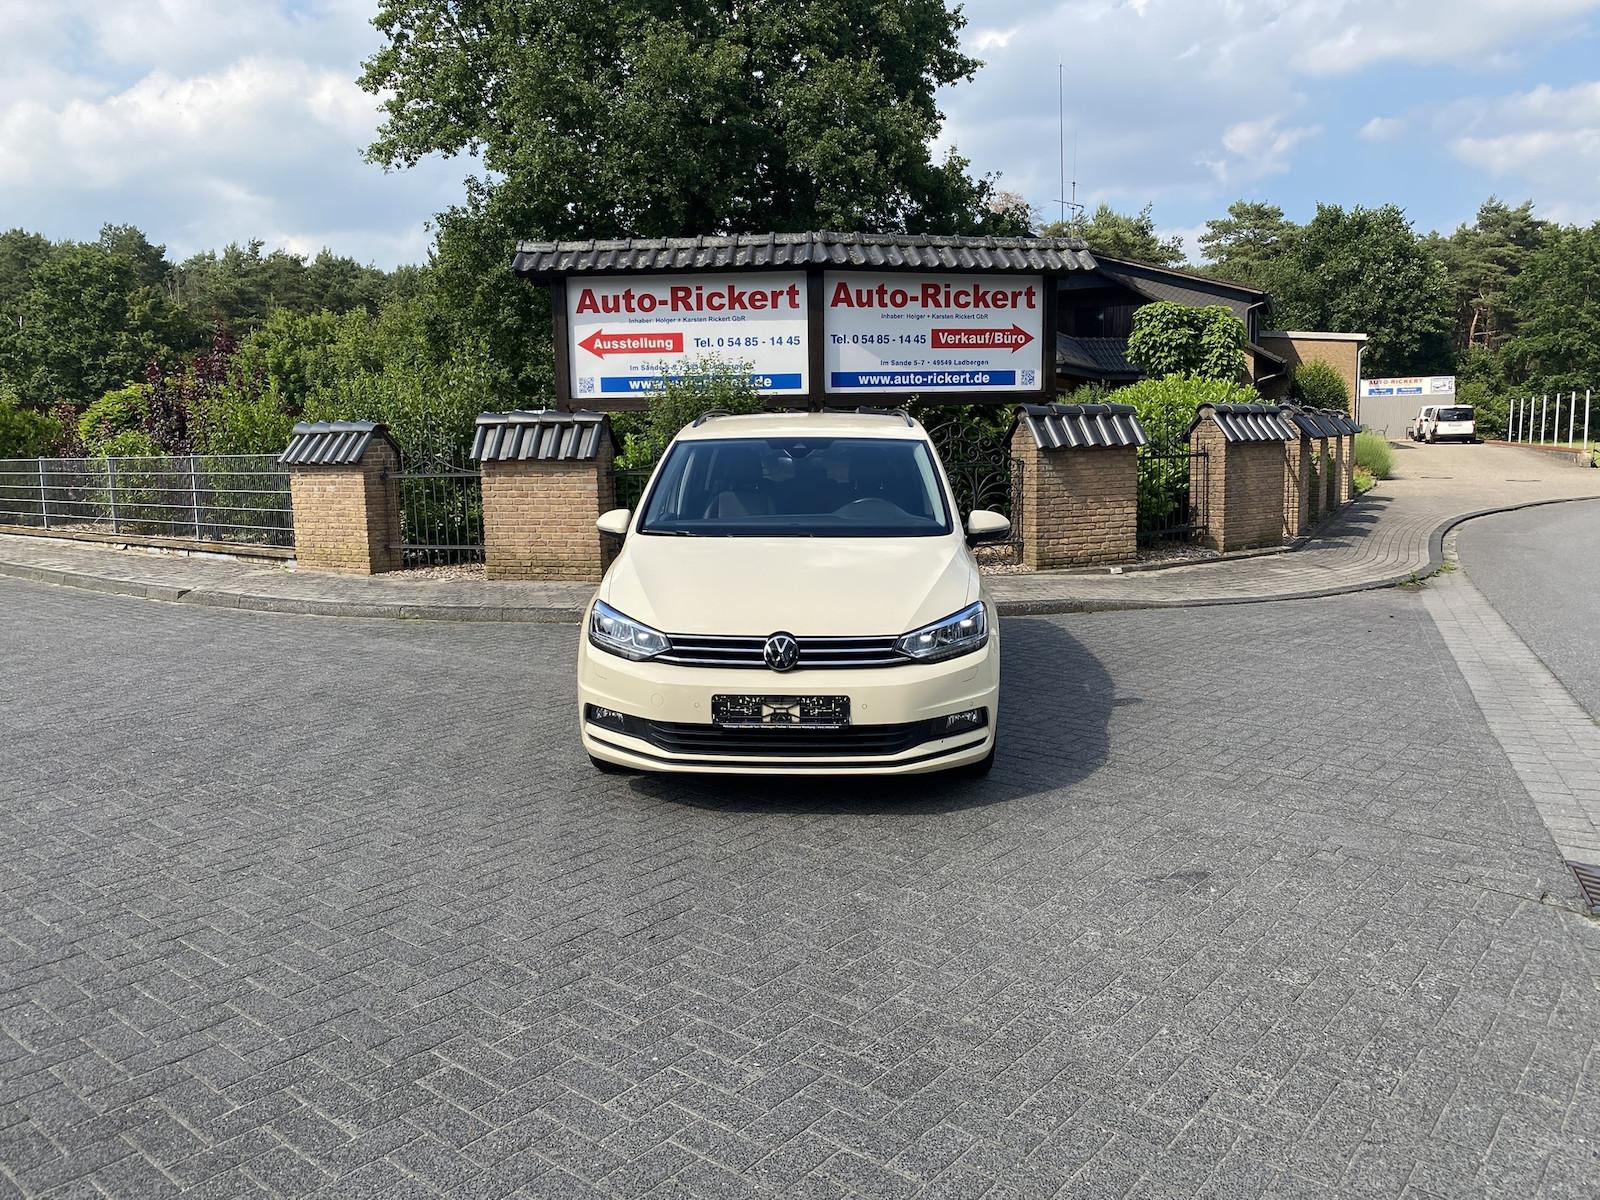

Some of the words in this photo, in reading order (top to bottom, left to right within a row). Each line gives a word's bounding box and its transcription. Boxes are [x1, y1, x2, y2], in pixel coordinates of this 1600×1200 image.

[576, 283, 800, 314] Auto-Rickert
[830, 282, 1036, 309] Auto-Rickert
[593, 338, 674, 351] Ausstellung
[693, 337, 714, 348] Tel.
[830, 334, 850, 344] Tel.
[938, 332, 1026, 346] Verkauf/Büro
[858, 371, 990, 385] www.auto-rickert.de
